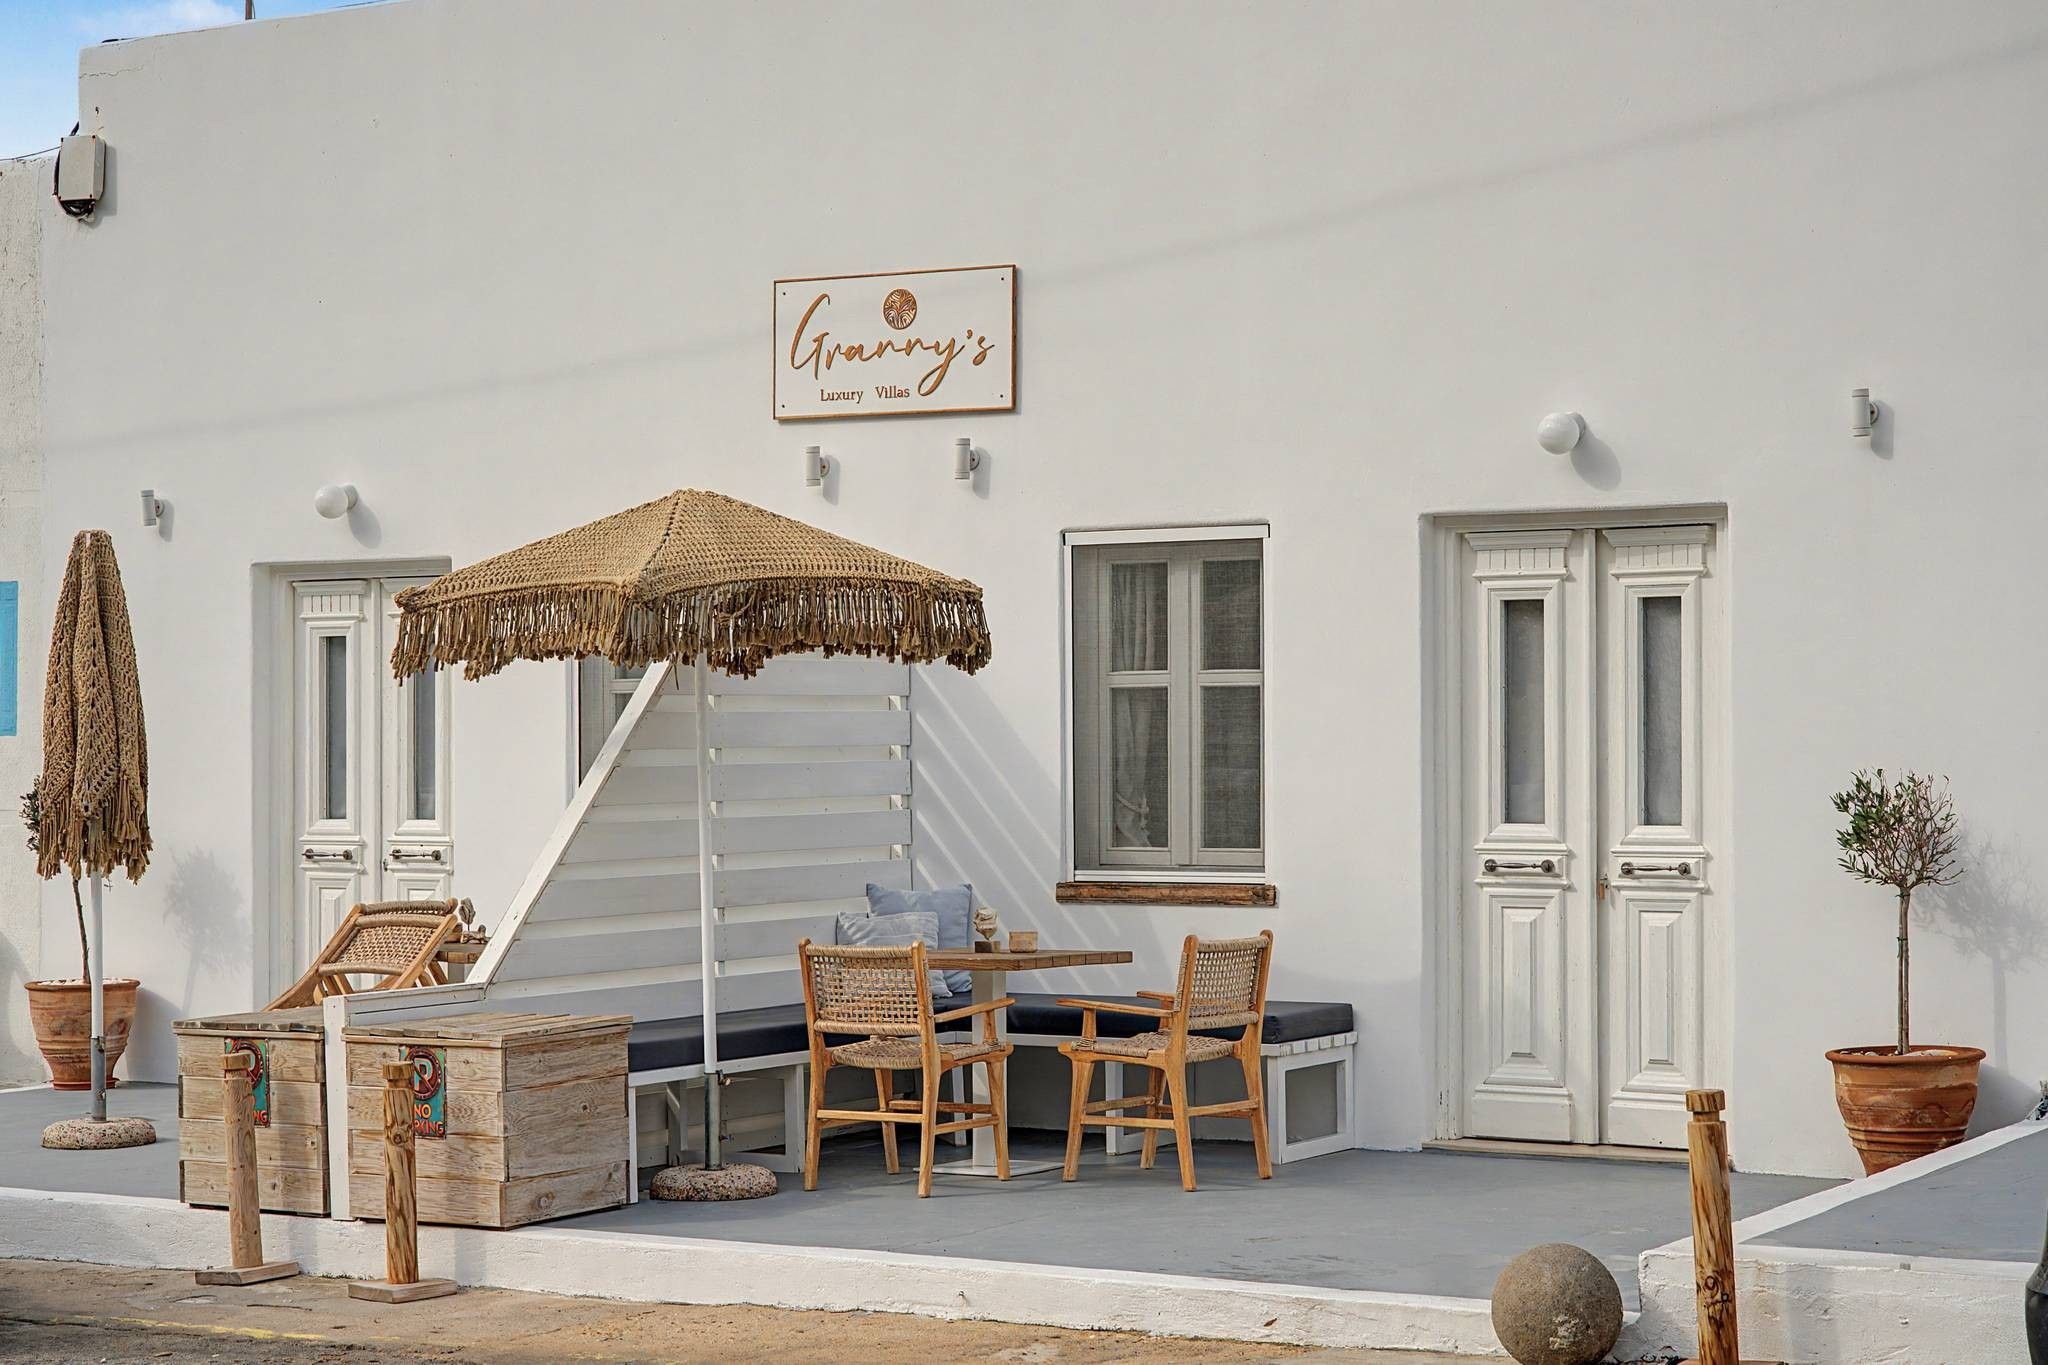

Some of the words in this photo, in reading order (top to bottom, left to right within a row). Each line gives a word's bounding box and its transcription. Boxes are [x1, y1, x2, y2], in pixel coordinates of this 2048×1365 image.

[790, 292, 995, 397] Granny's
[820, 388, 864, 404] Luxury
[875, 385, 910, 400] Villas
[414, 1103, 432, 1119] NO
[414, 1120, 444, 1135] RKING
